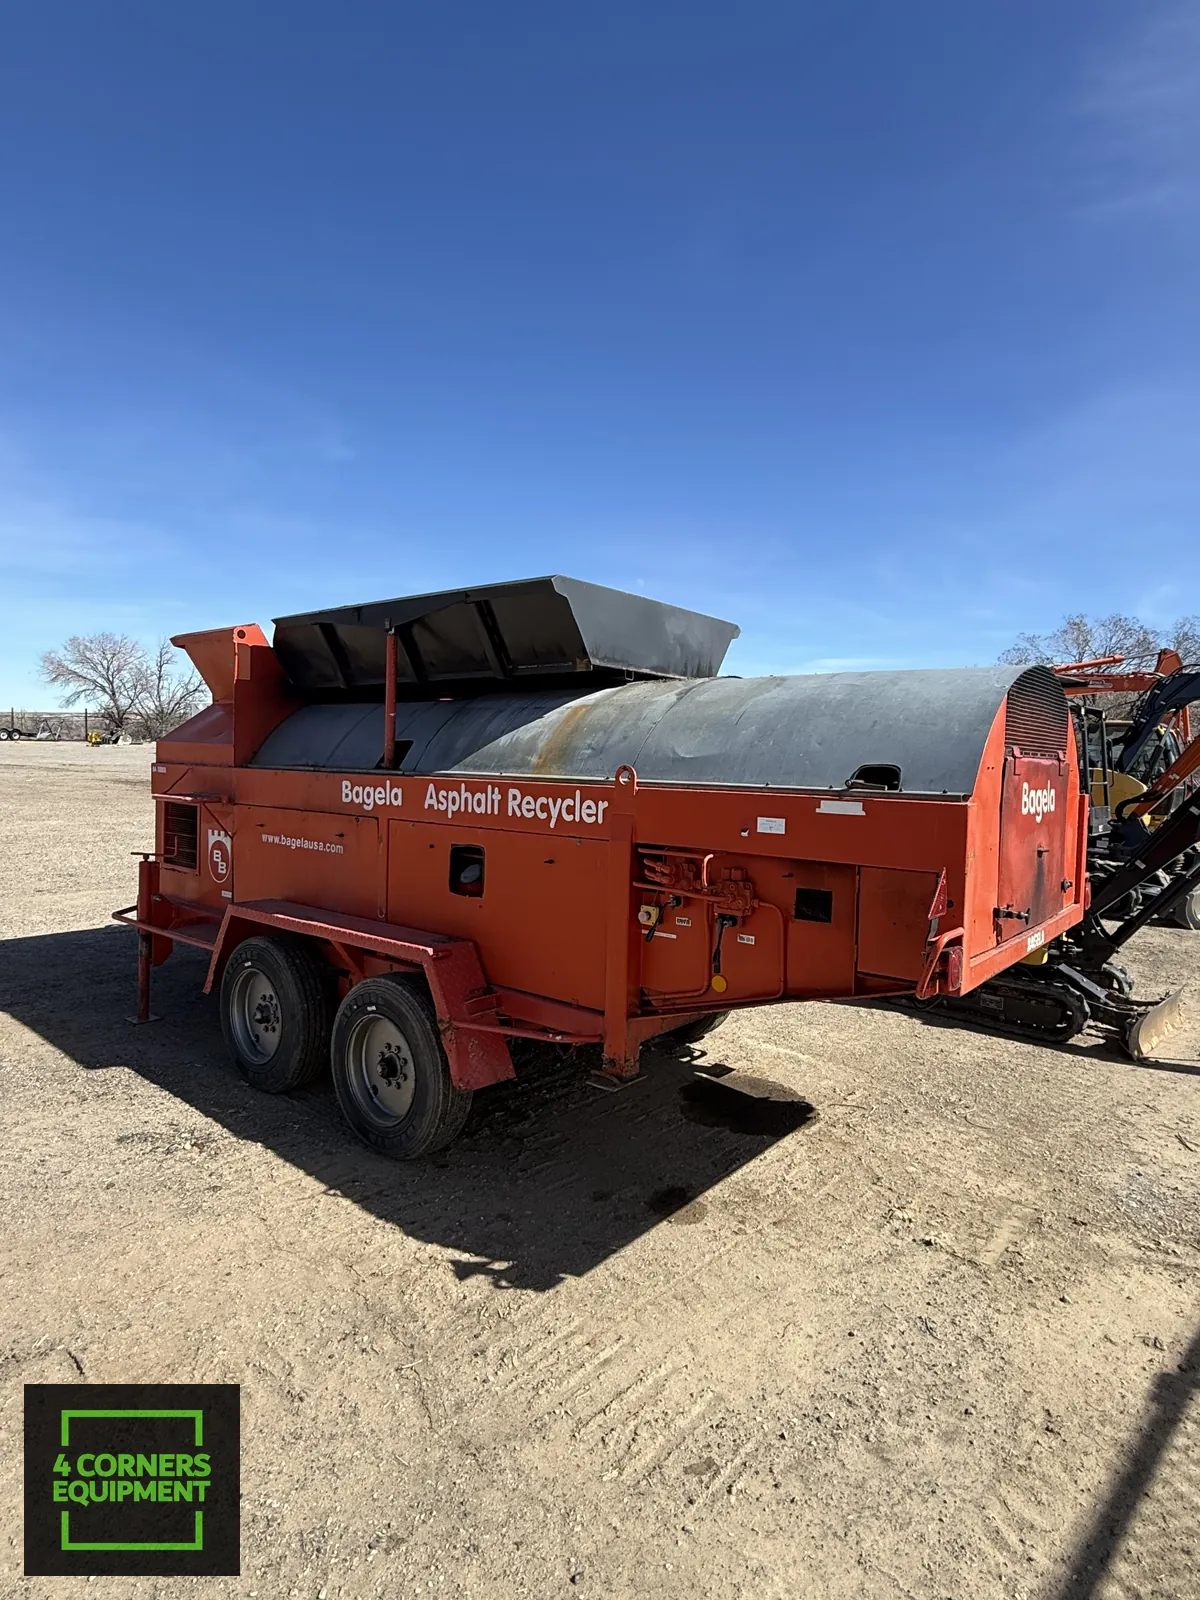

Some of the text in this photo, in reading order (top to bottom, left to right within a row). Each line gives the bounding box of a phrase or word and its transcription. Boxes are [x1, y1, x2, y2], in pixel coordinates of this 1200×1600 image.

[342, 780, 609, 829] Bagela Asphalt Recycler
[1021, 779, 1056, 824] Bagela
[261, 833, 344, 855] www.bagelausa.com
